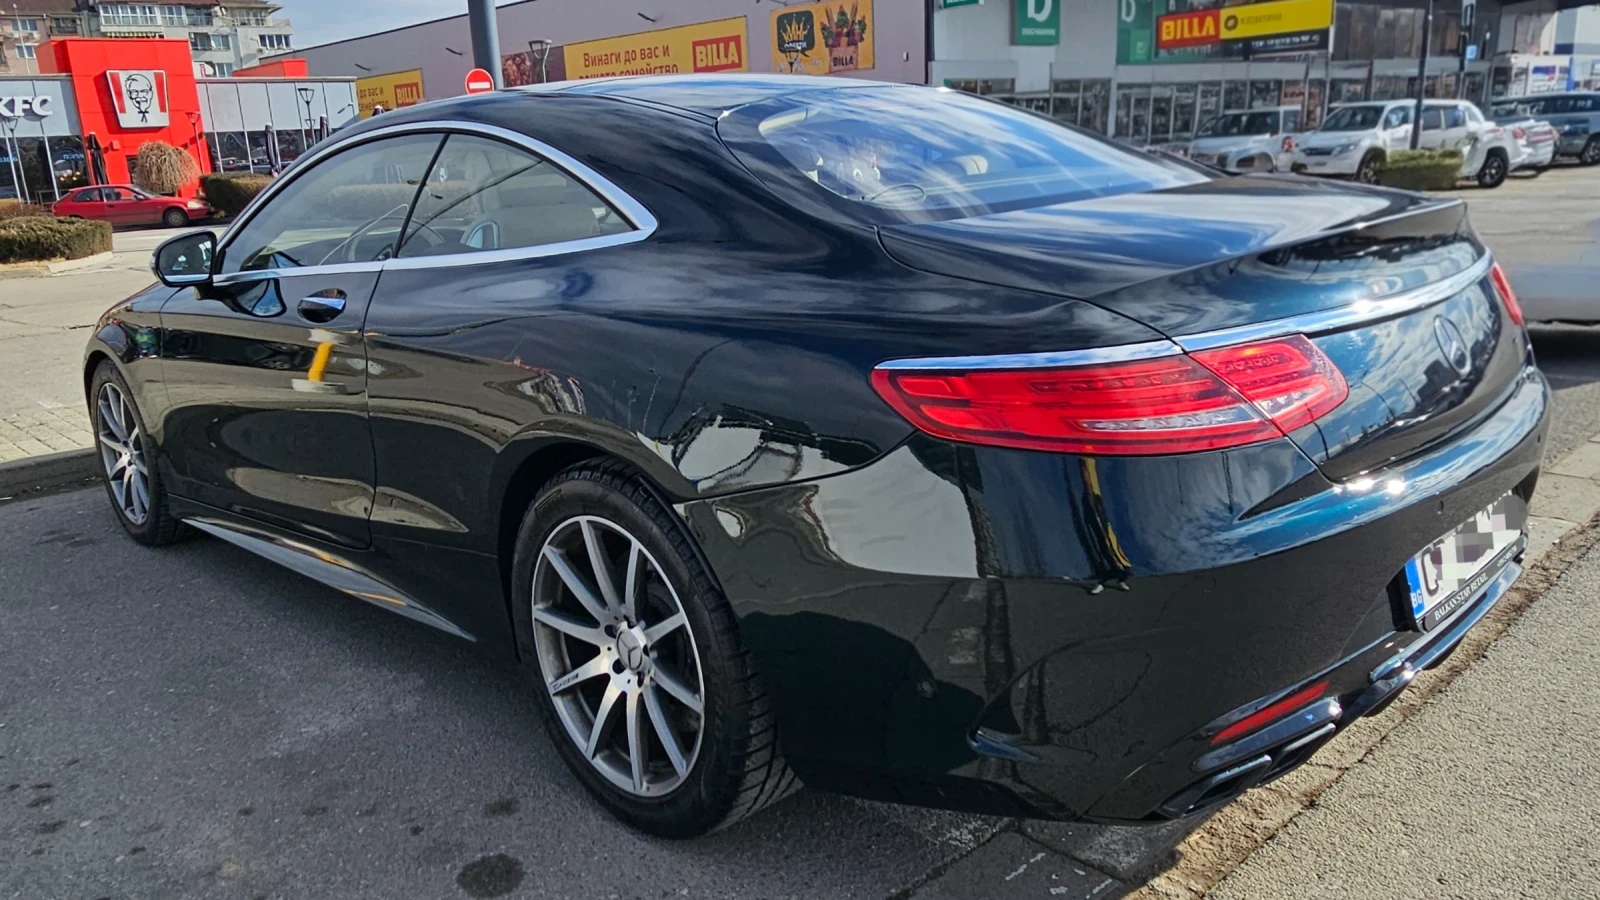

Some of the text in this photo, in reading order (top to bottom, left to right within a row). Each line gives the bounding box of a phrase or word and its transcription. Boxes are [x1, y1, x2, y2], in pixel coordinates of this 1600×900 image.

[1161, 16, 1216, 41] BILLA
[583, 44, 670, 68] Винаги до вас и
[695, 41, 739, 68] BILLA
[833, 56, 854, 67] BILLA
[1410, 590, 1423, 608] BG
